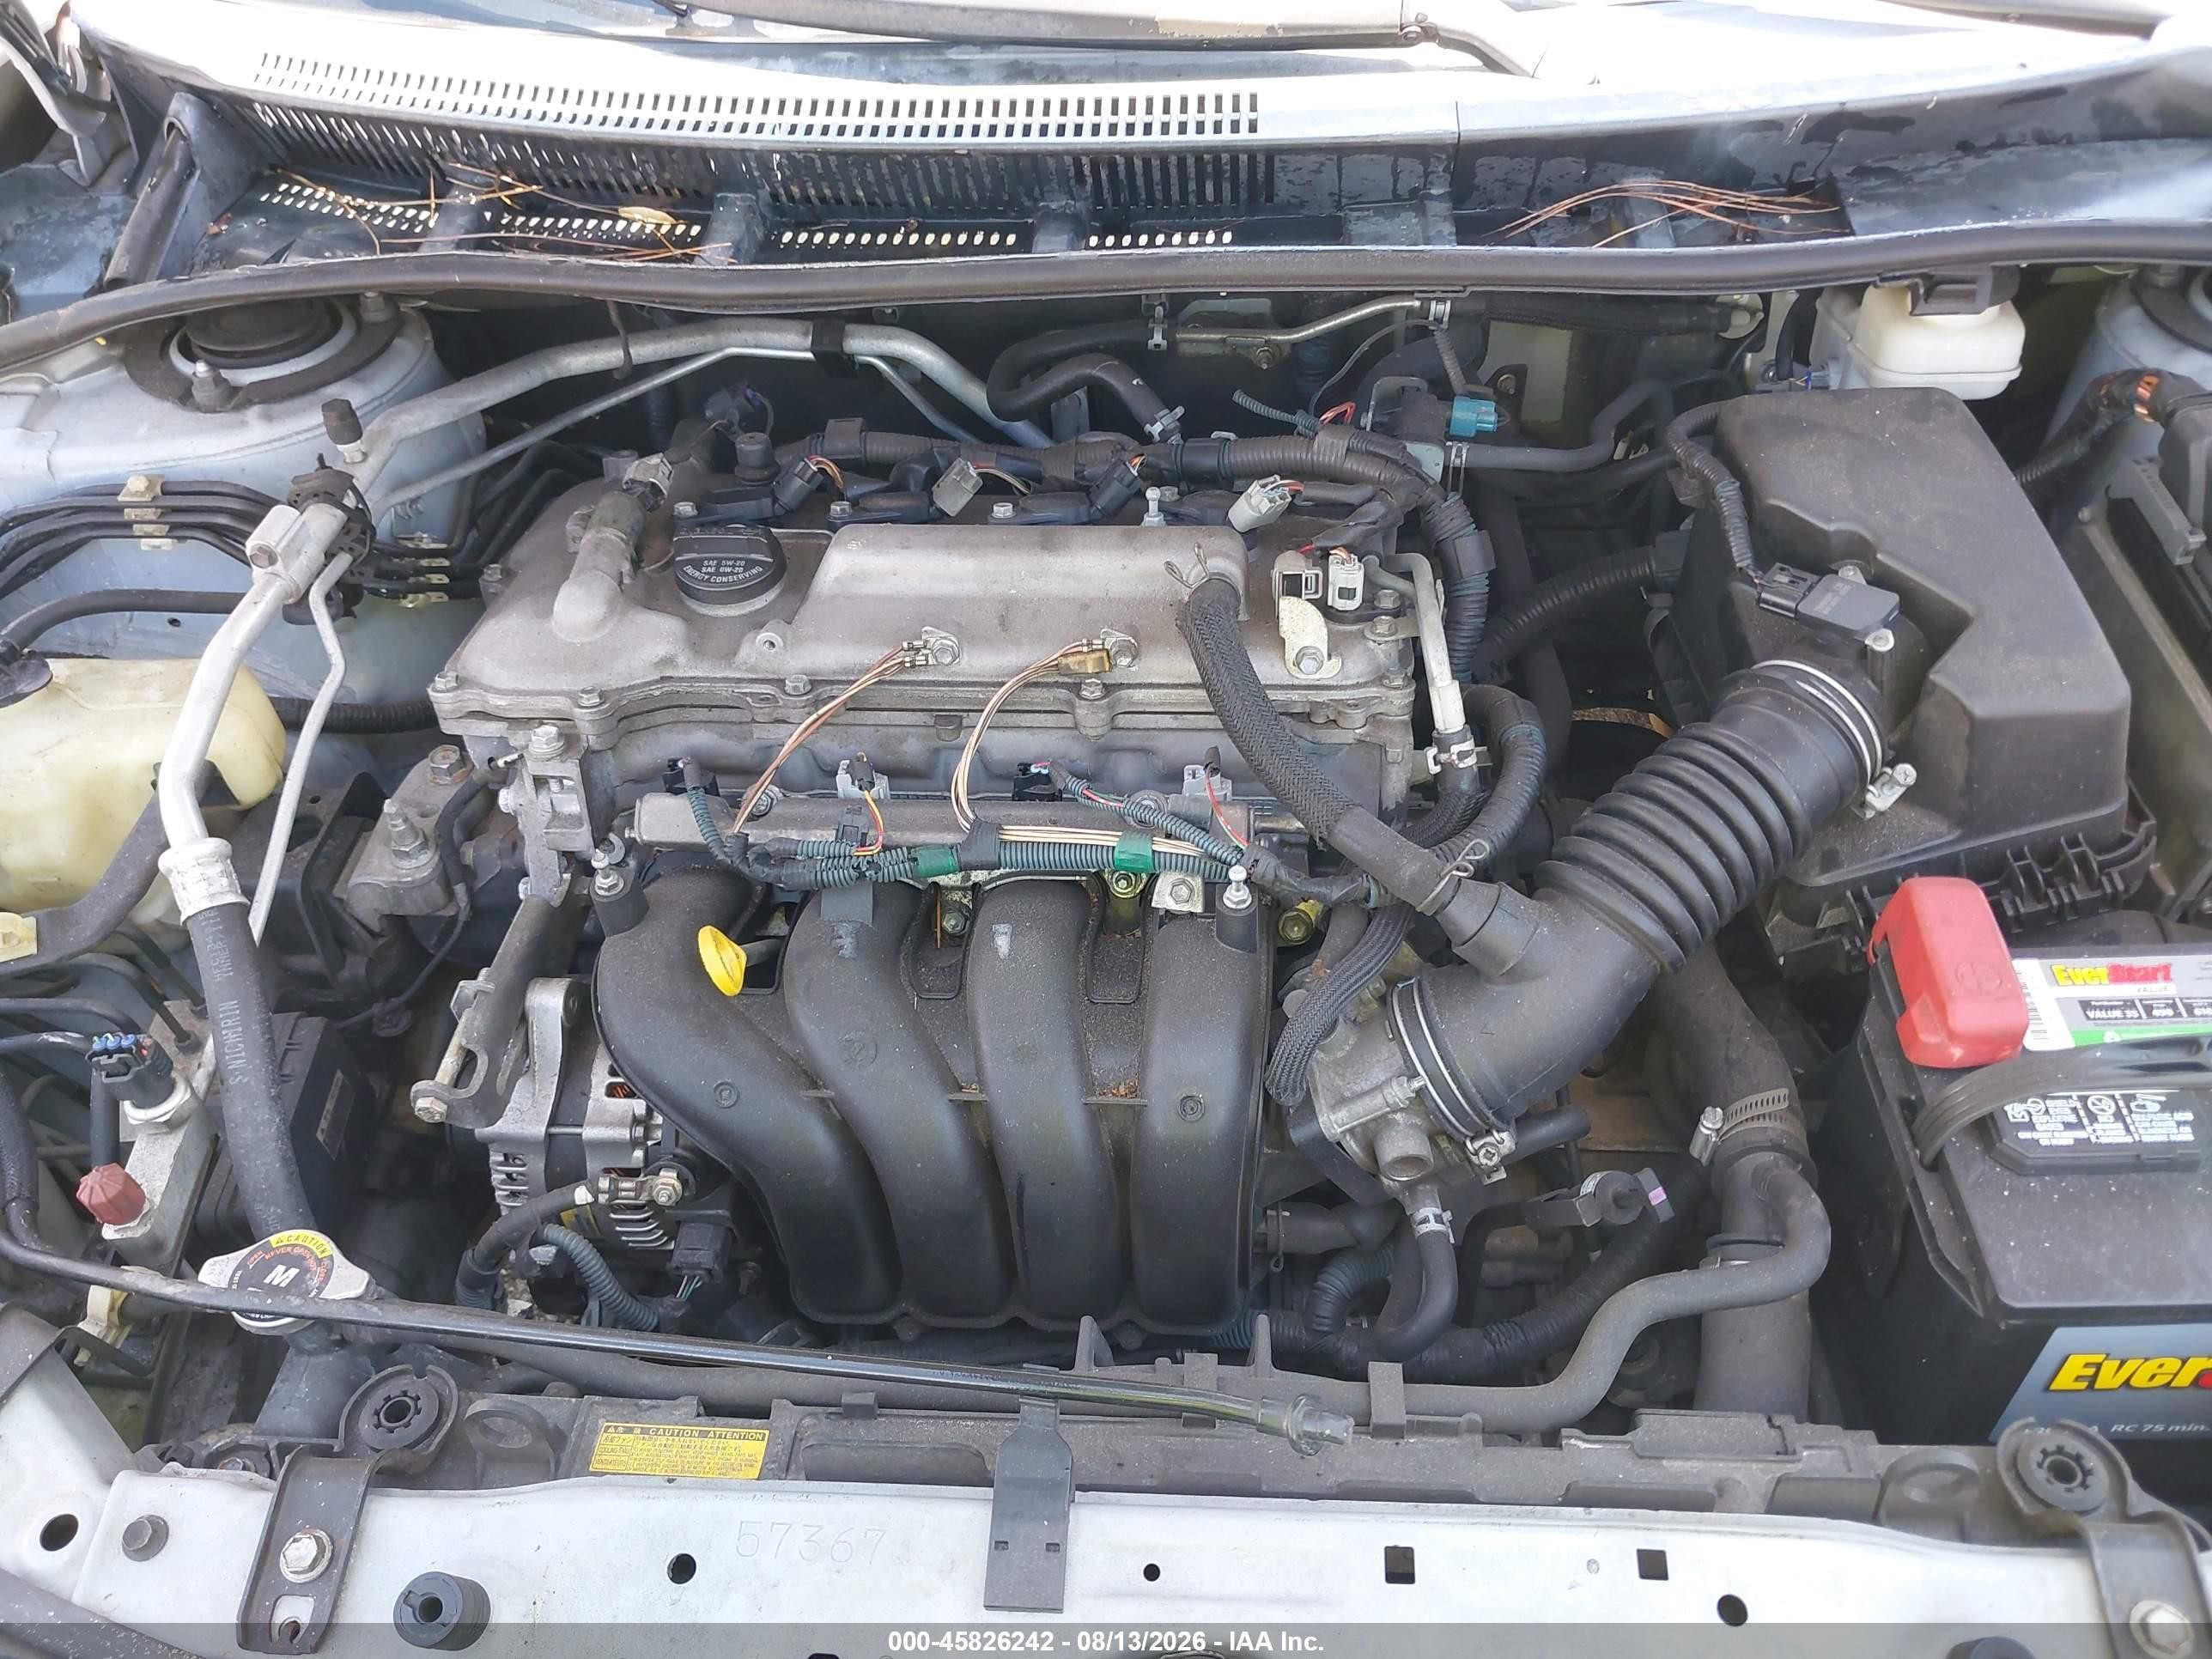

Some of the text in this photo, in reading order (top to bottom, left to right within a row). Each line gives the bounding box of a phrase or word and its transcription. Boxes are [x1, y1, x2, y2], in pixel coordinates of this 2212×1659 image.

[684, 565, 763, 583] ENERGY CONSERVING
[2051, 962, 2173, 987] EverStart
[264, 1246, 292, 1261] NEVER
[287, 1233, 328, 1255] CAUTION
[263, 1264, 301, 1288] M
[2049, 1353, 2212, 1391] Ever
[649, 1428, 700, 1438] CAUTION
[708, 1431, 763, 1440] ATTENTION
[2111, 1422, 2210, 1433] RC 75 min.
[736, 1521, 888, 1565] 57367
